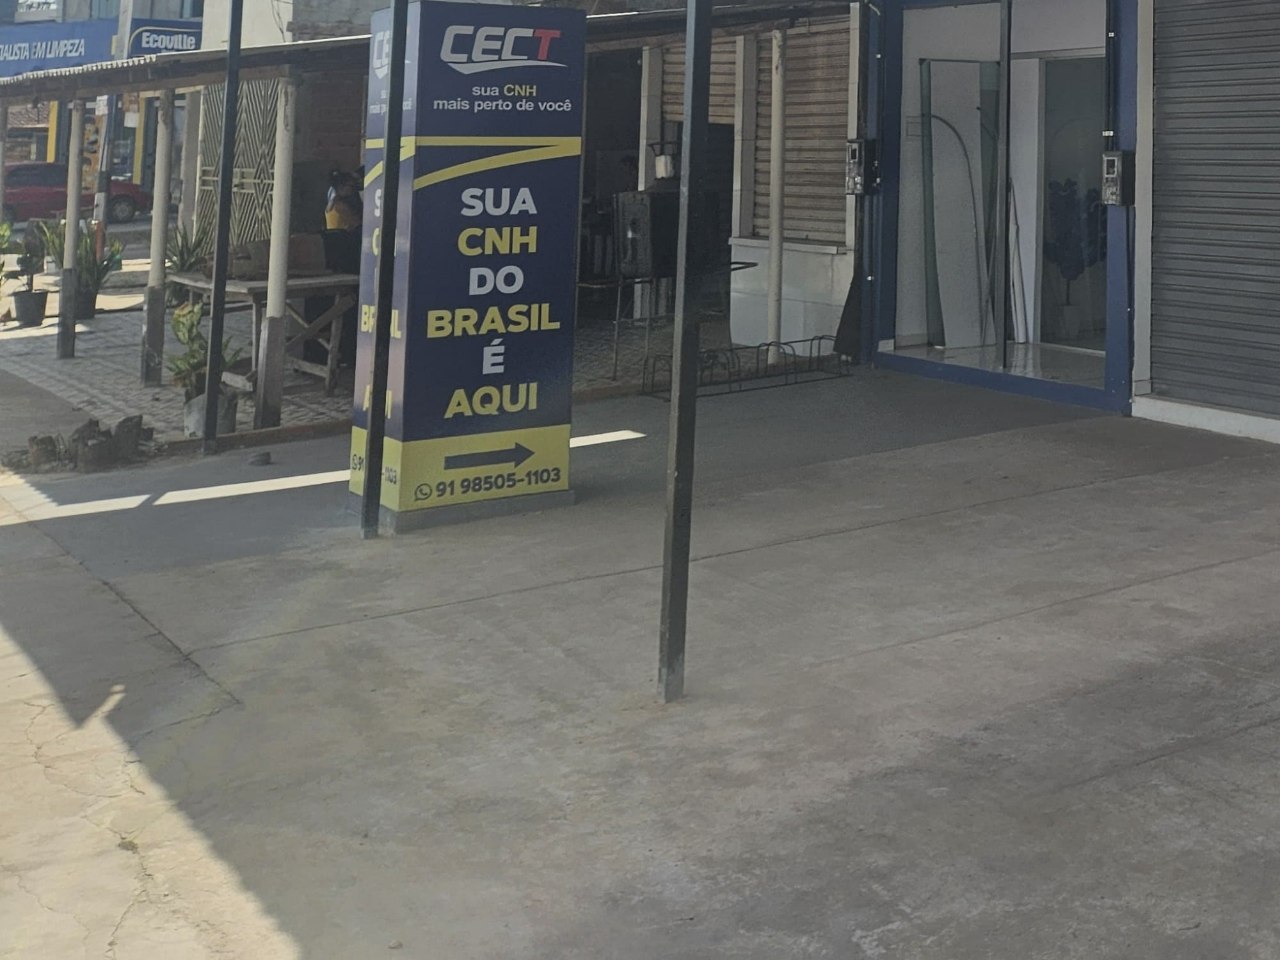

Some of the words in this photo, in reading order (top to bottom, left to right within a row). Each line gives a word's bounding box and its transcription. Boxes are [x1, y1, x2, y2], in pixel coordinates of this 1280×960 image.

[32, 41, 46, 59] EM
[46, 38, 85, 58] LIMPEZA
[142, 32, 196, 51] Ecoville
[440, 25, 561, 63] CECT
[433, 97, 470, 111] mais
[474, 99, 513, 113] perto
[516, 98, 534, 112] de
[538, 99, 572, 112] você
[472, 86, 499, 97] sua
[503, 84, 537, 97] CNH
[460, 187, 538, 217] SUA
[457, 225, 538, 256] CNH
[468, 265, 524, 296] DO
[426, 303, 561, 338] BRASIL
[482, 338, 505, 375] É
[443, 382, 538, 419] AQUI
[436, 481, 454, 498] 91
[460, 467, 561, 495] 98505-1103
